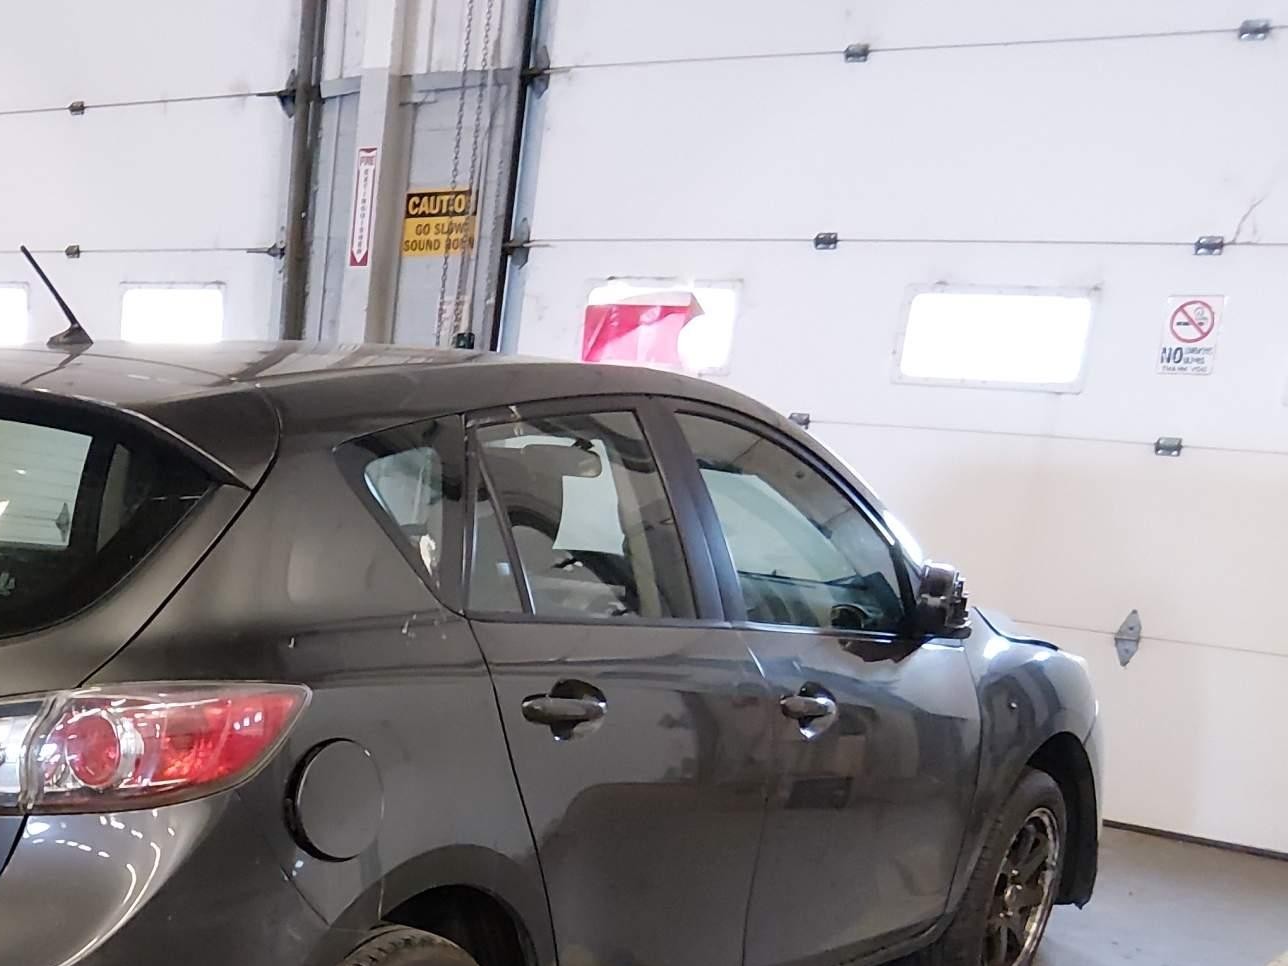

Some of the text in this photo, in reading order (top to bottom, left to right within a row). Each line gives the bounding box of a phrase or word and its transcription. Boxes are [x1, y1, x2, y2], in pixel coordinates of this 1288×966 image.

[408, 193, 468, 215] CAUTO
[415, 223, 430, 236] GO
[403, 239, 441, 252] SOUND
[1160, 346, 1183, 364] NO
